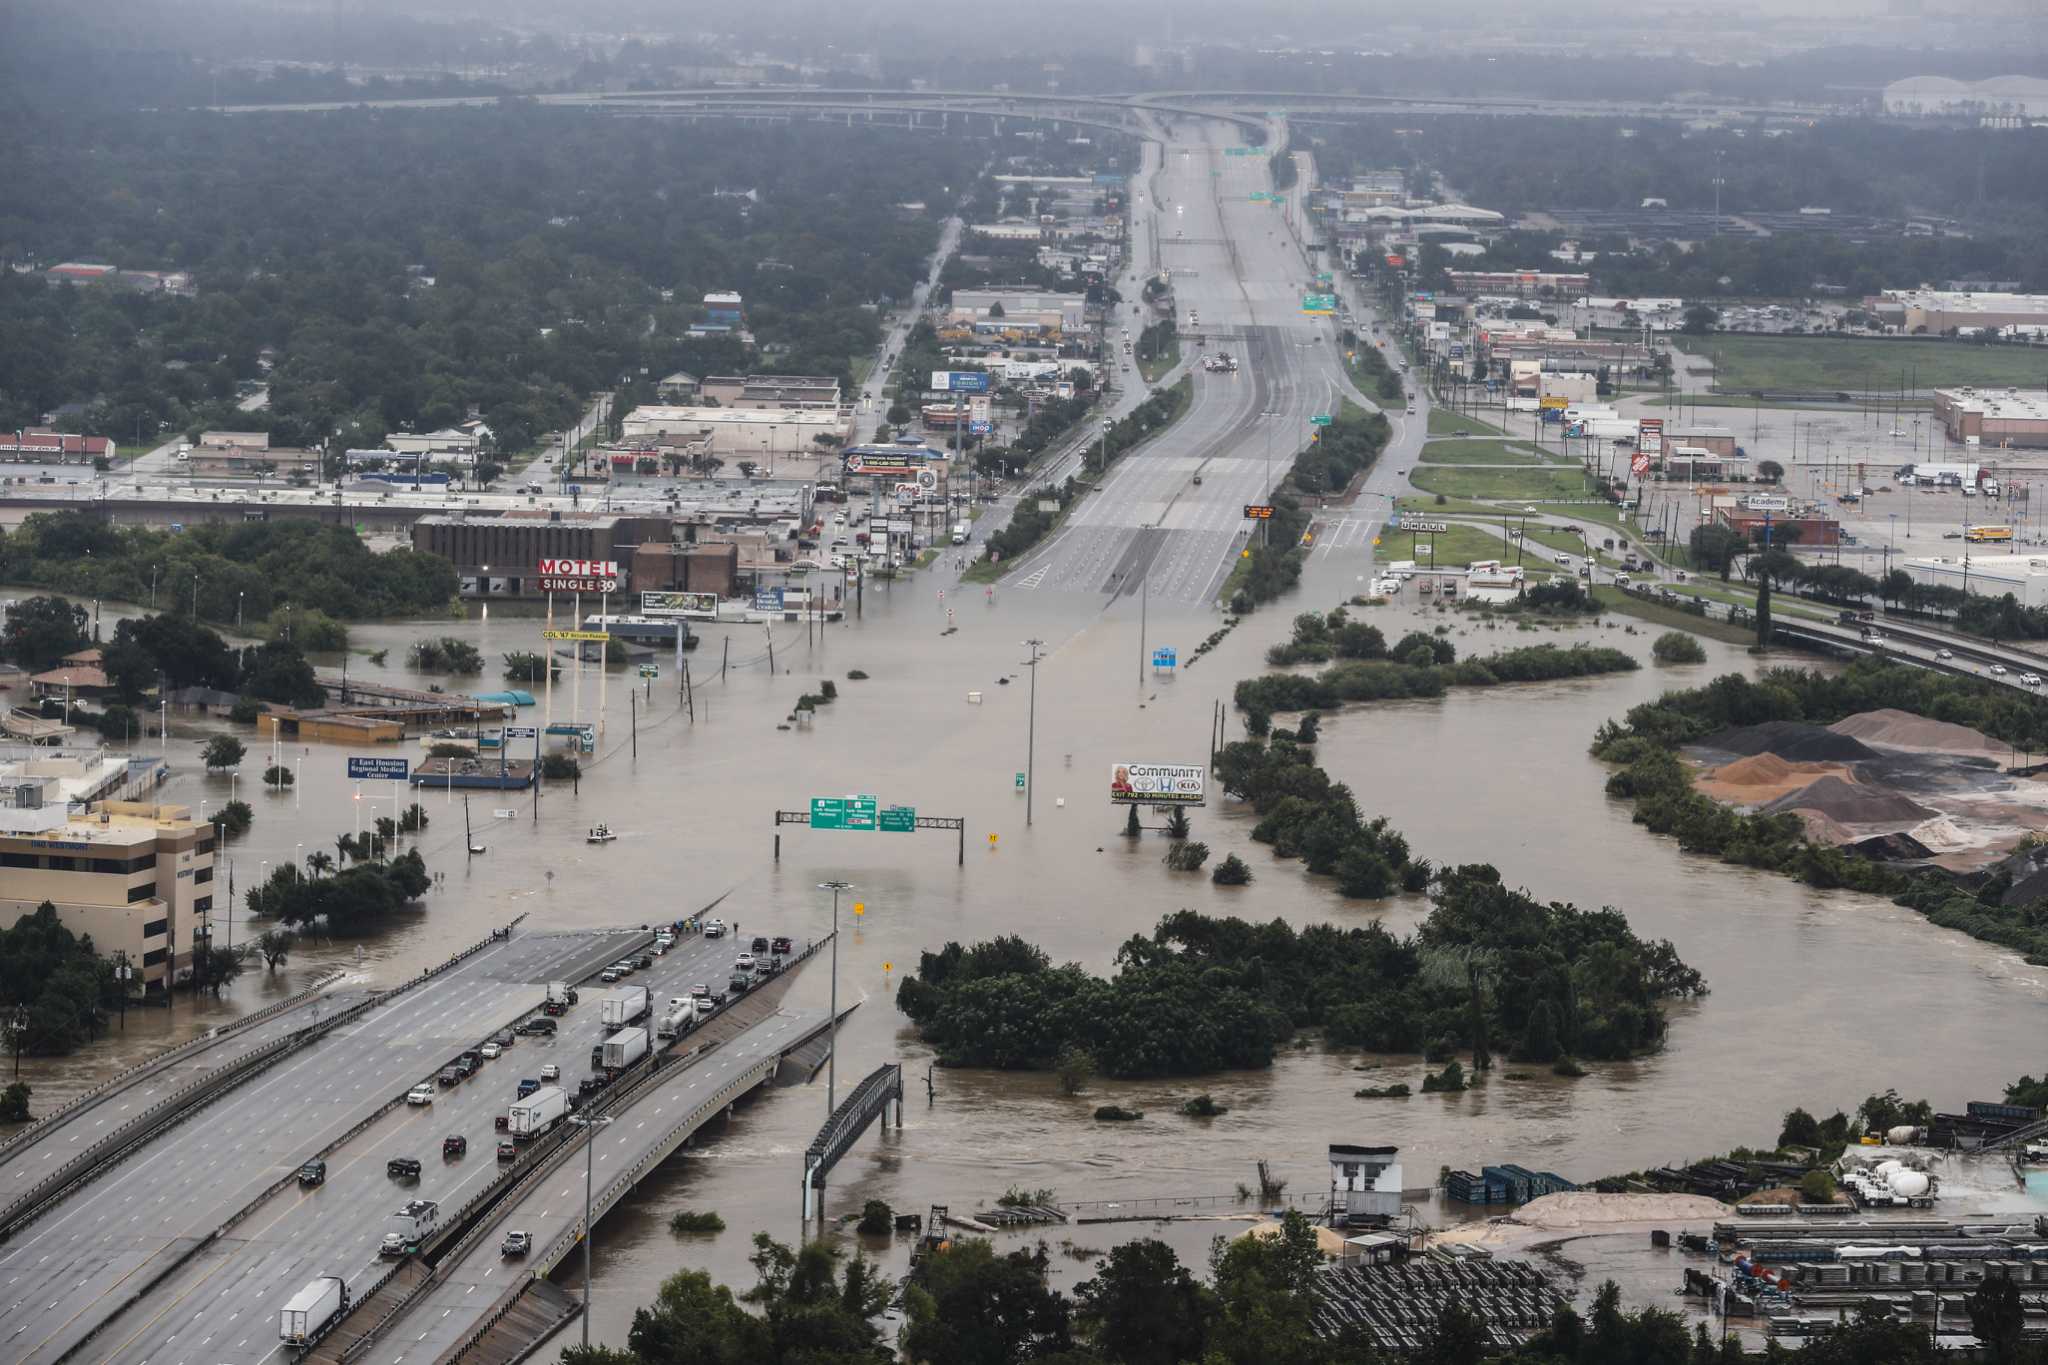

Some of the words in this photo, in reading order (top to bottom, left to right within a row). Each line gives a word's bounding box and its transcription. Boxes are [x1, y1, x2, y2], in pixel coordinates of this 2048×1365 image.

[539, 559, 617, 577] MOTEL
[543, 579, 595, 591] SINGLE
[598, 580, 617, 593] 39
[376, 759, 405, 767] Houston
